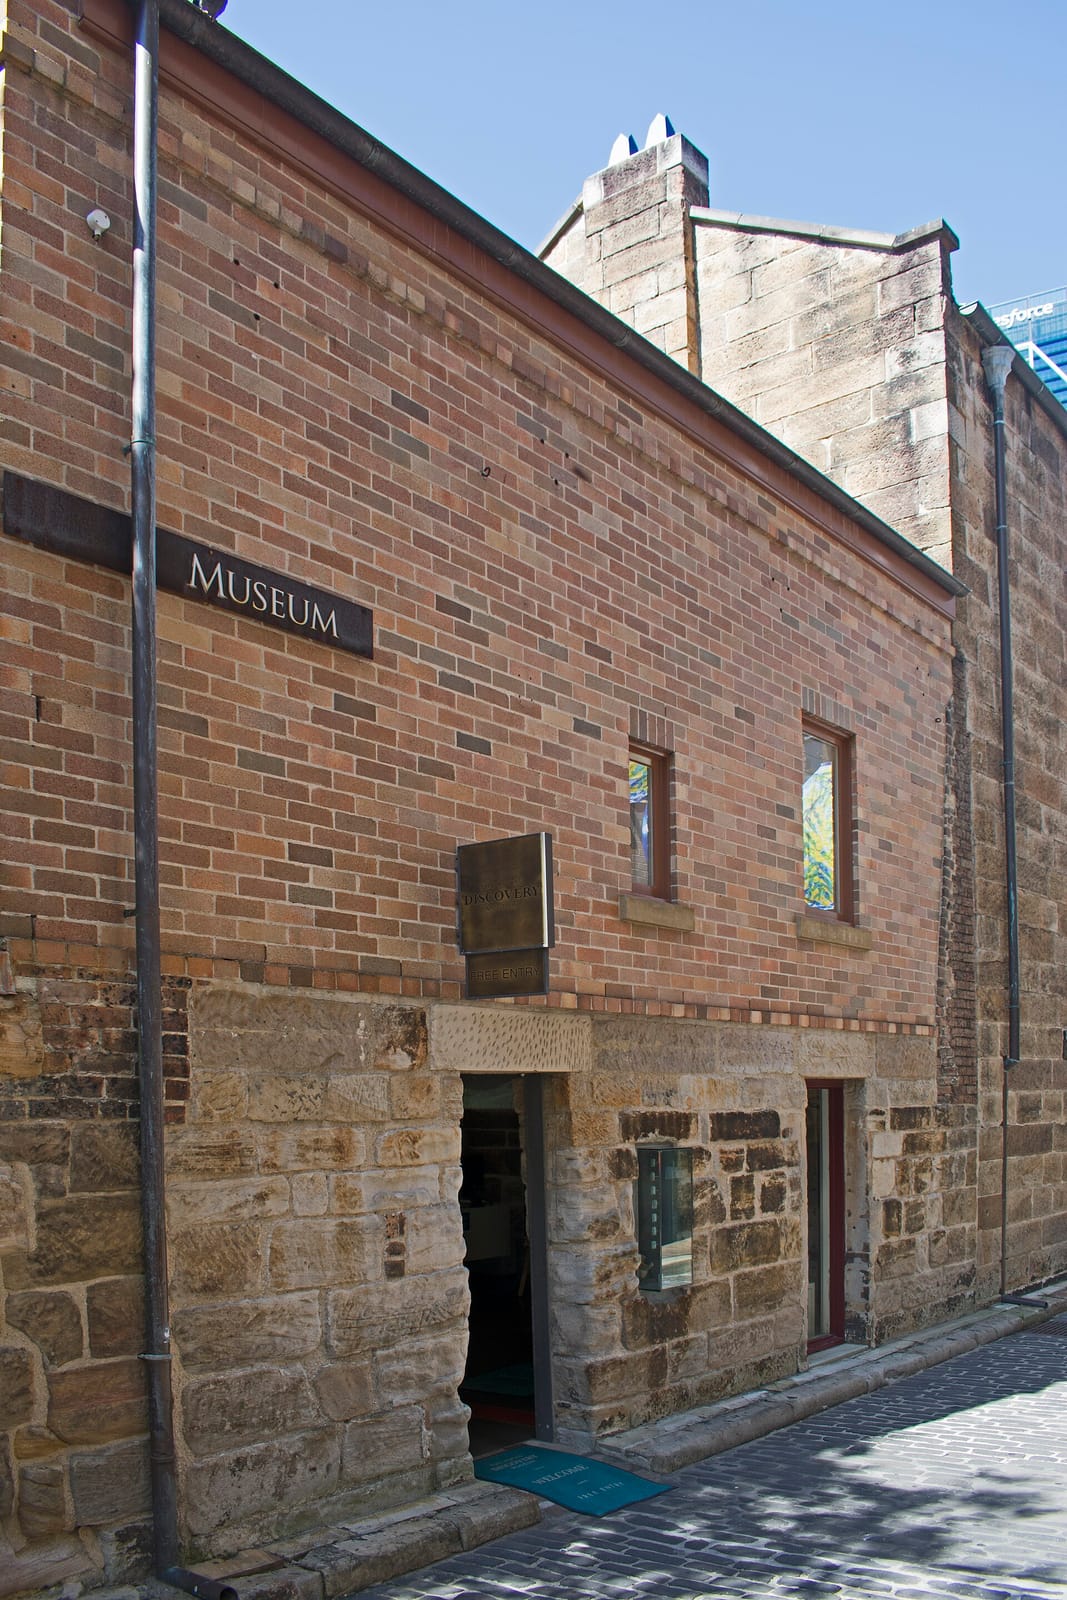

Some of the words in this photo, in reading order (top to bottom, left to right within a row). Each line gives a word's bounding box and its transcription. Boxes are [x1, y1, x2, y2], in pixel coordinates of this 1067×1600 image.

[186, 553, 340, 639] MUSEUM
[464, 886, 538, 905] DISCOVERY
[470, 969, 499, 981] FREE
[502, 966, 540, 979] ENTRY
[532, 1464, 590, 1485] WELCOME
